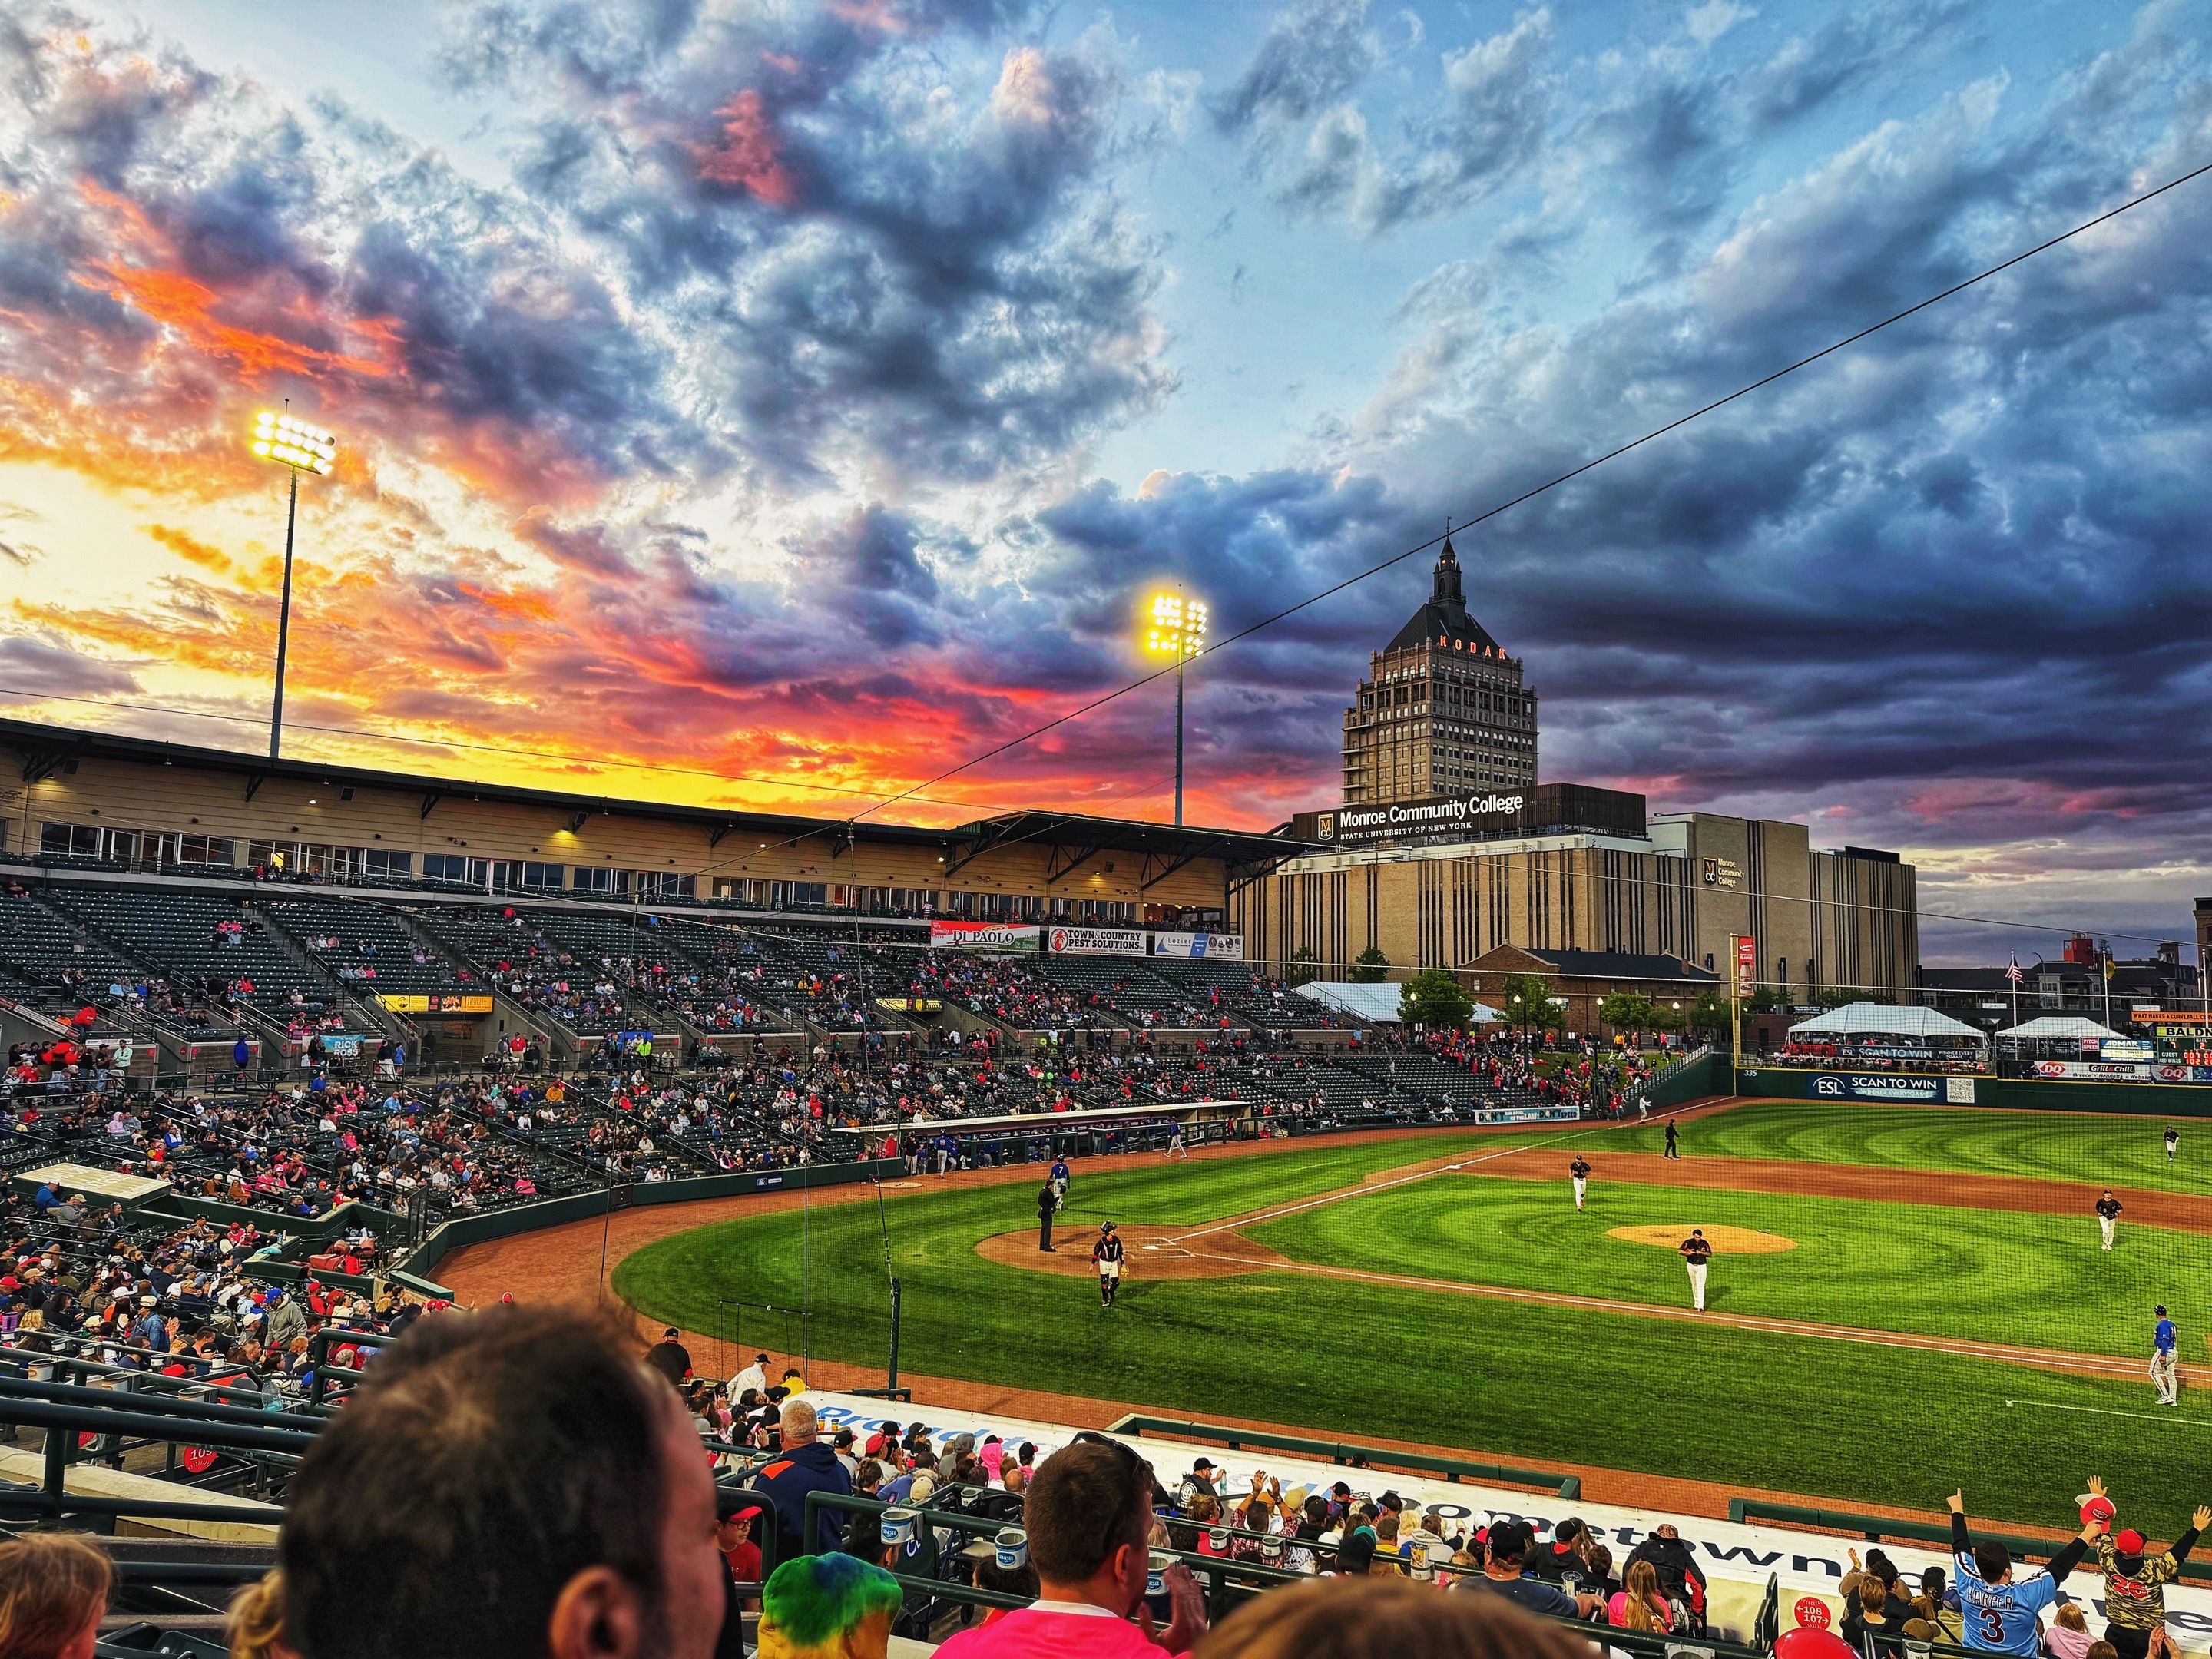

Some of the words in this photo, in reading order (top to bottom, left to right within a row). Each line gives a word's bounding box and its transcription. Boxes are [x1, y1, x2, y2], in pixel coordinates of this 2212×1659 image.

[1440, 635, 1505, 660] KODAK
[1340, 811, 1386, 828] Monroe
[1389, 800, 1467, 823] Community
[1469, 794, 1523, 815] College
[1366, 828, 1412, 838] UNIVERSITY
[1449, 822, 1472, 830] YORK
[1718, 858, 1736, 867] Monroe
[1718, 867, 1744, 879] Community
[1718, 876, 1736, 887] College
[953, 931, 968, 942] DI
[973, 931, 1014, 943] PAOLO
[1068, 939, 1090, 948] PEST
[1092, 939, 1140, 949] SOLUTIONS
[1859, 1048, 1889, 1058] SCAN
[1892, 1049, 1906, 1058] TO
[1909, 1050, 1932, 1058] WIN
[2045, 1065, 2062, 1074] DQ
[2164, 1068, 2183, 1078] DQ
[1818, 1081, 1843, 1094] ESL
[1852, 1077, 1886, 1088] SCAN
[1889, 1078, 1906, 1088] TO
[1909, 1079, 1937, 1090] WIN
[2111, 1574, 2149, 1598] 26
[1968, 1586, 2013, 1611] HARPER
[1803, 1606, 1822, 1616] 108
[1803, 1614, 1822, 1624] 107
[1979, 1608, 2005, 1644] 3
